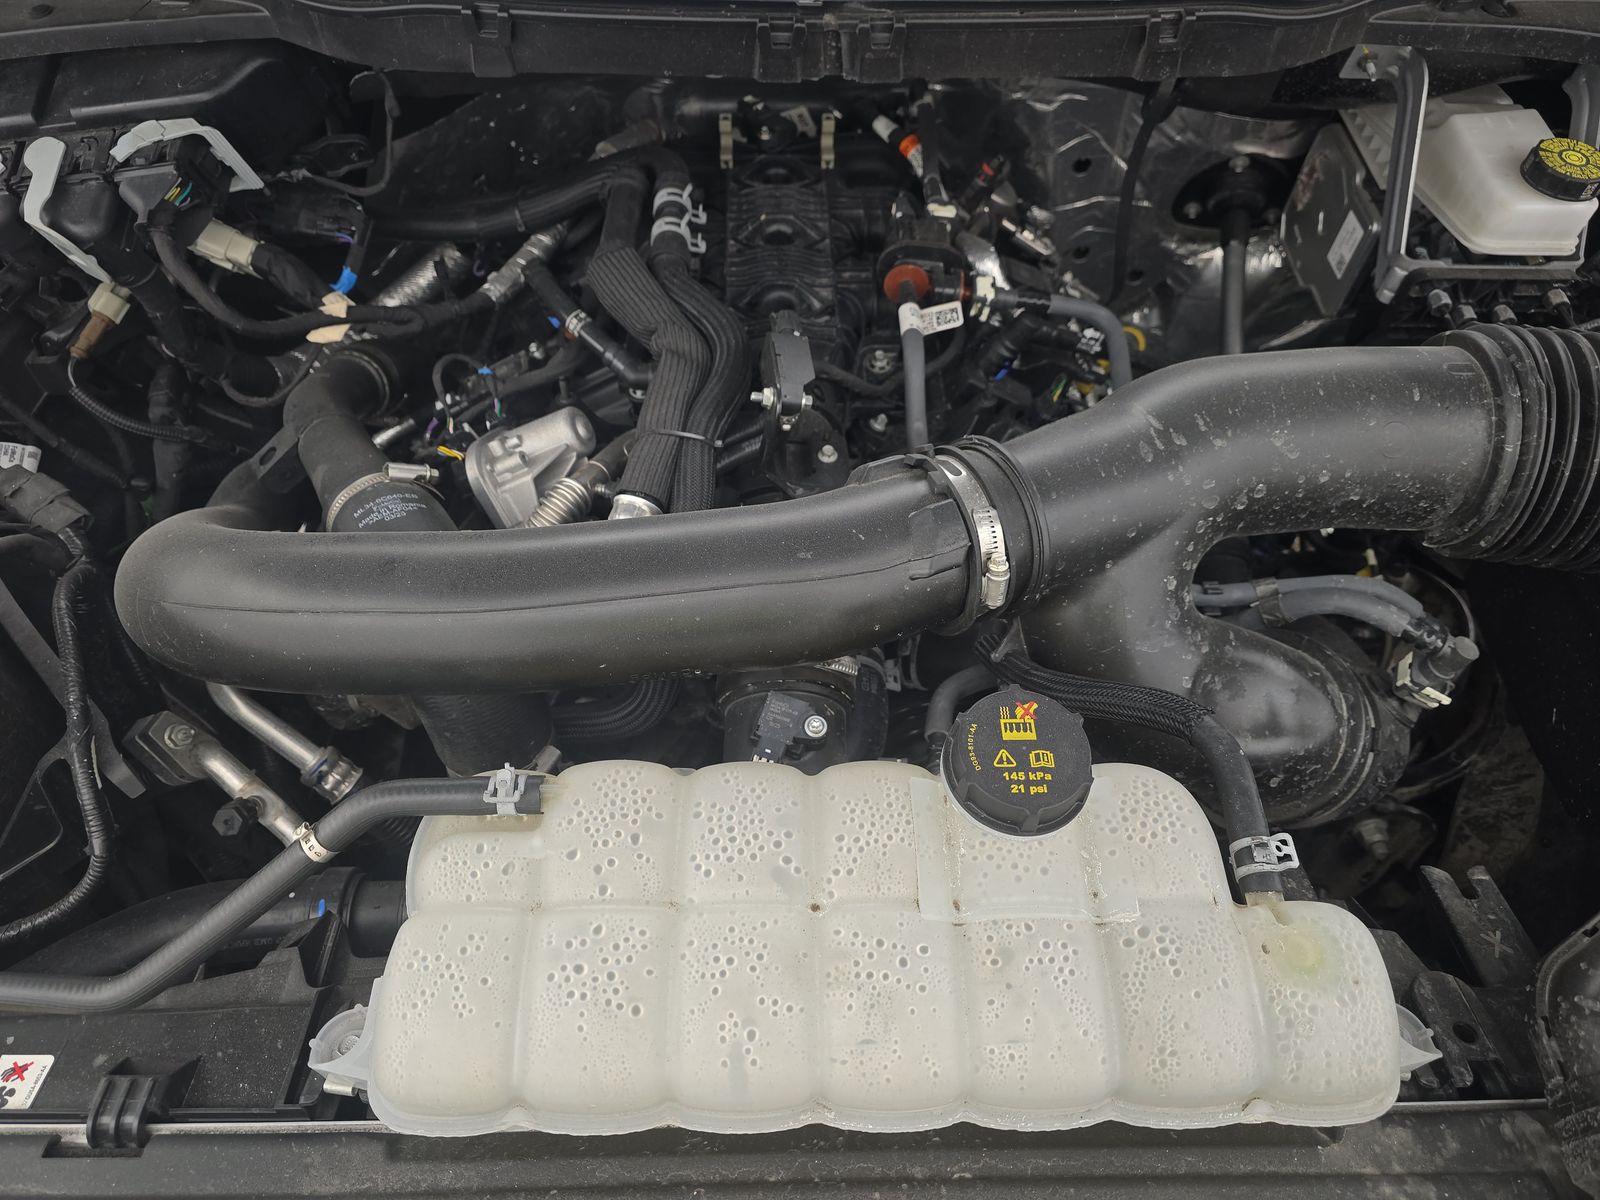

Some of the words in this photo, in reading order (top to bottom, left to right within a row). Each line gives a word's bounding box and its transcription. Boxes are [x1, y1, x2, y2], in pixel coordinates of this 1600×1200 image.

[1003, 771, 1026, 781] 145
[1028, 771, 1052, 781] kPa
[1010, 783, 1025, 793] 21
[1029, 784, 1048, 795] psi
